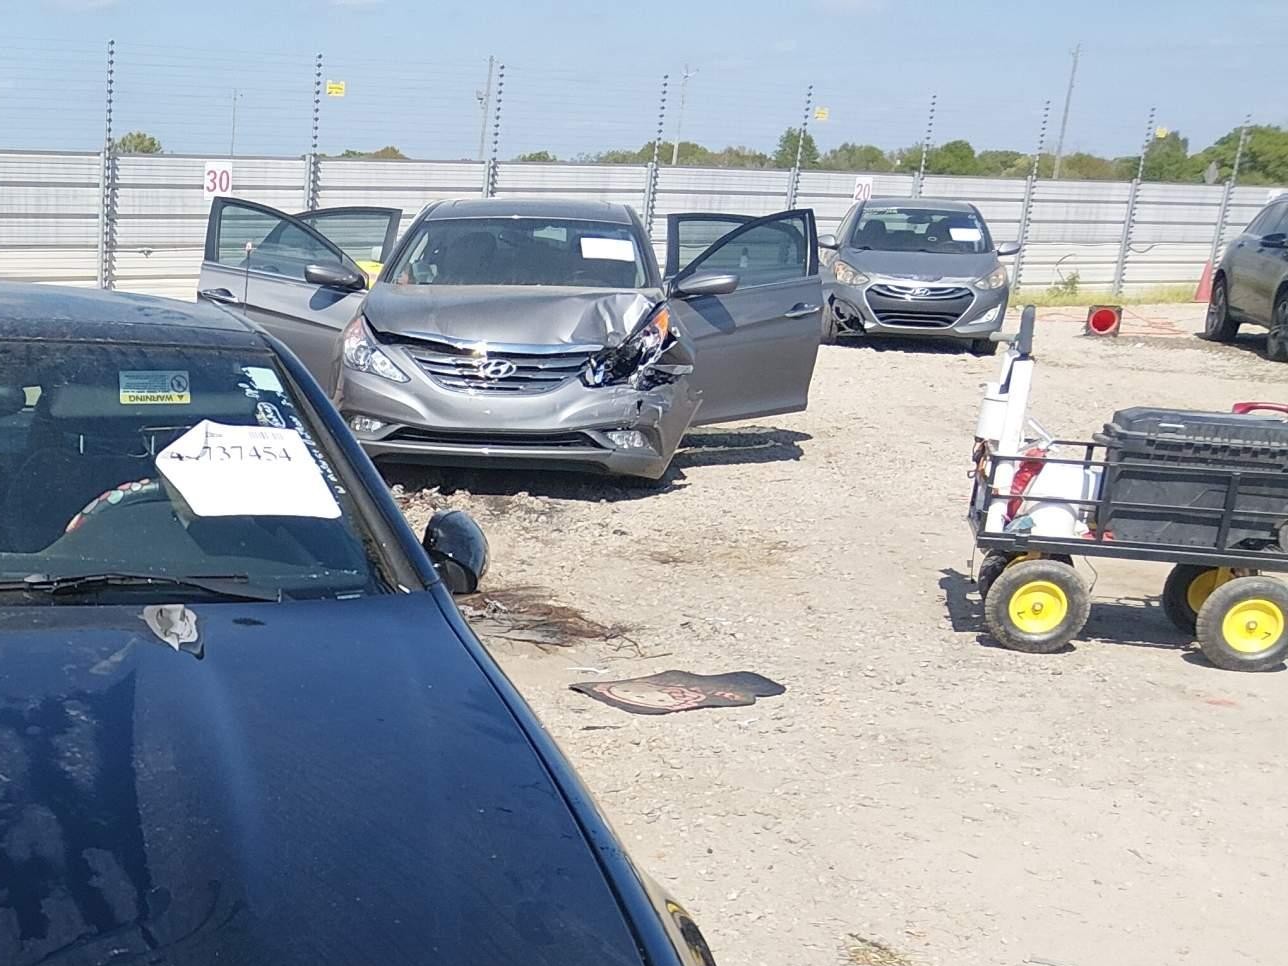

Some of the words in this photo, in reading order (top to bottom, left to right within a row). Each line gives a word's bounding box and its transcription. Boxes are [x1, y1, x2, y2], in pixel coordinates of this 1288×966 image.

[206, 169, 230, 193] 30
[854, 183, 871, 201] 20
[128, 394, 174, 402] WARNING
